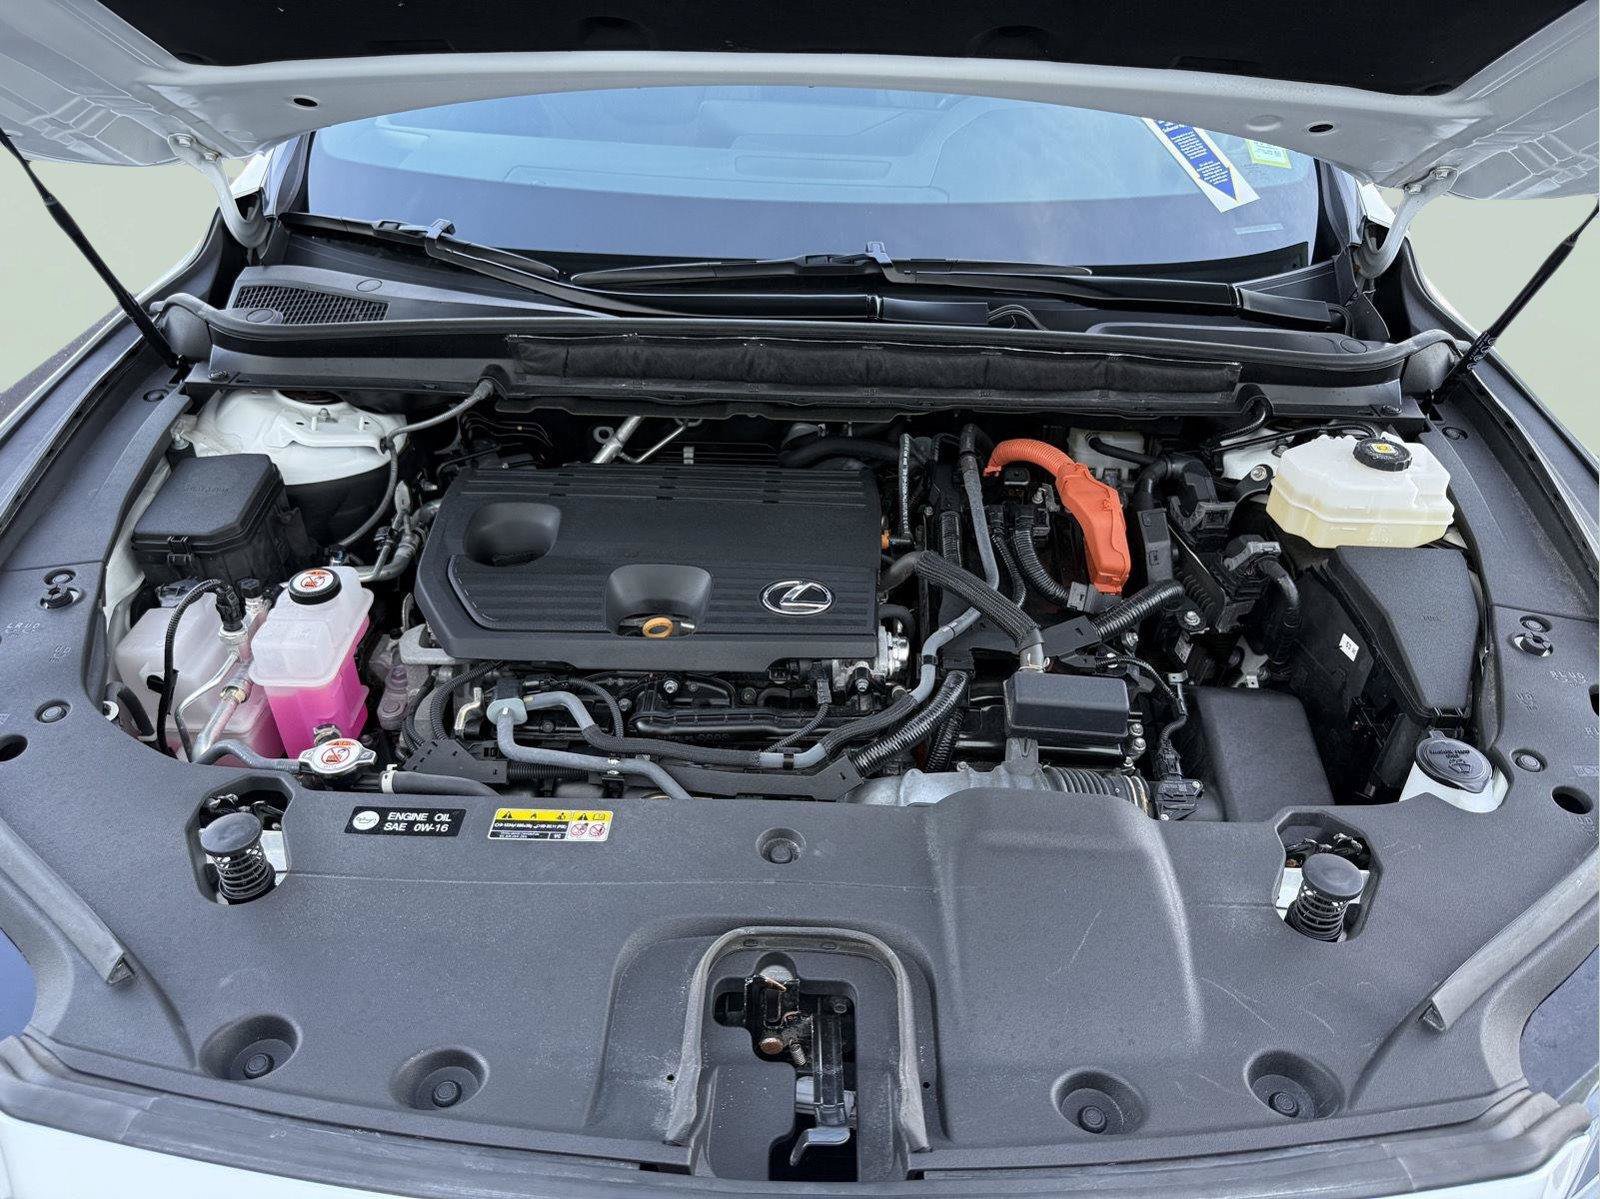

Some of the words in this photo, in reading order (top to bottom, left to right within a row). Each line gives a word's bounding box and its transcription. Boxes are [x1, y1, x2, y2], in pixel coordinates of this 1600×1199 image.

[387, 811, 429, 822] ENGINE
[434, 812, 452, 822] OIL
[383, 822, 407, 832] SAE
[413, 823, 449, 833] 0W-16
